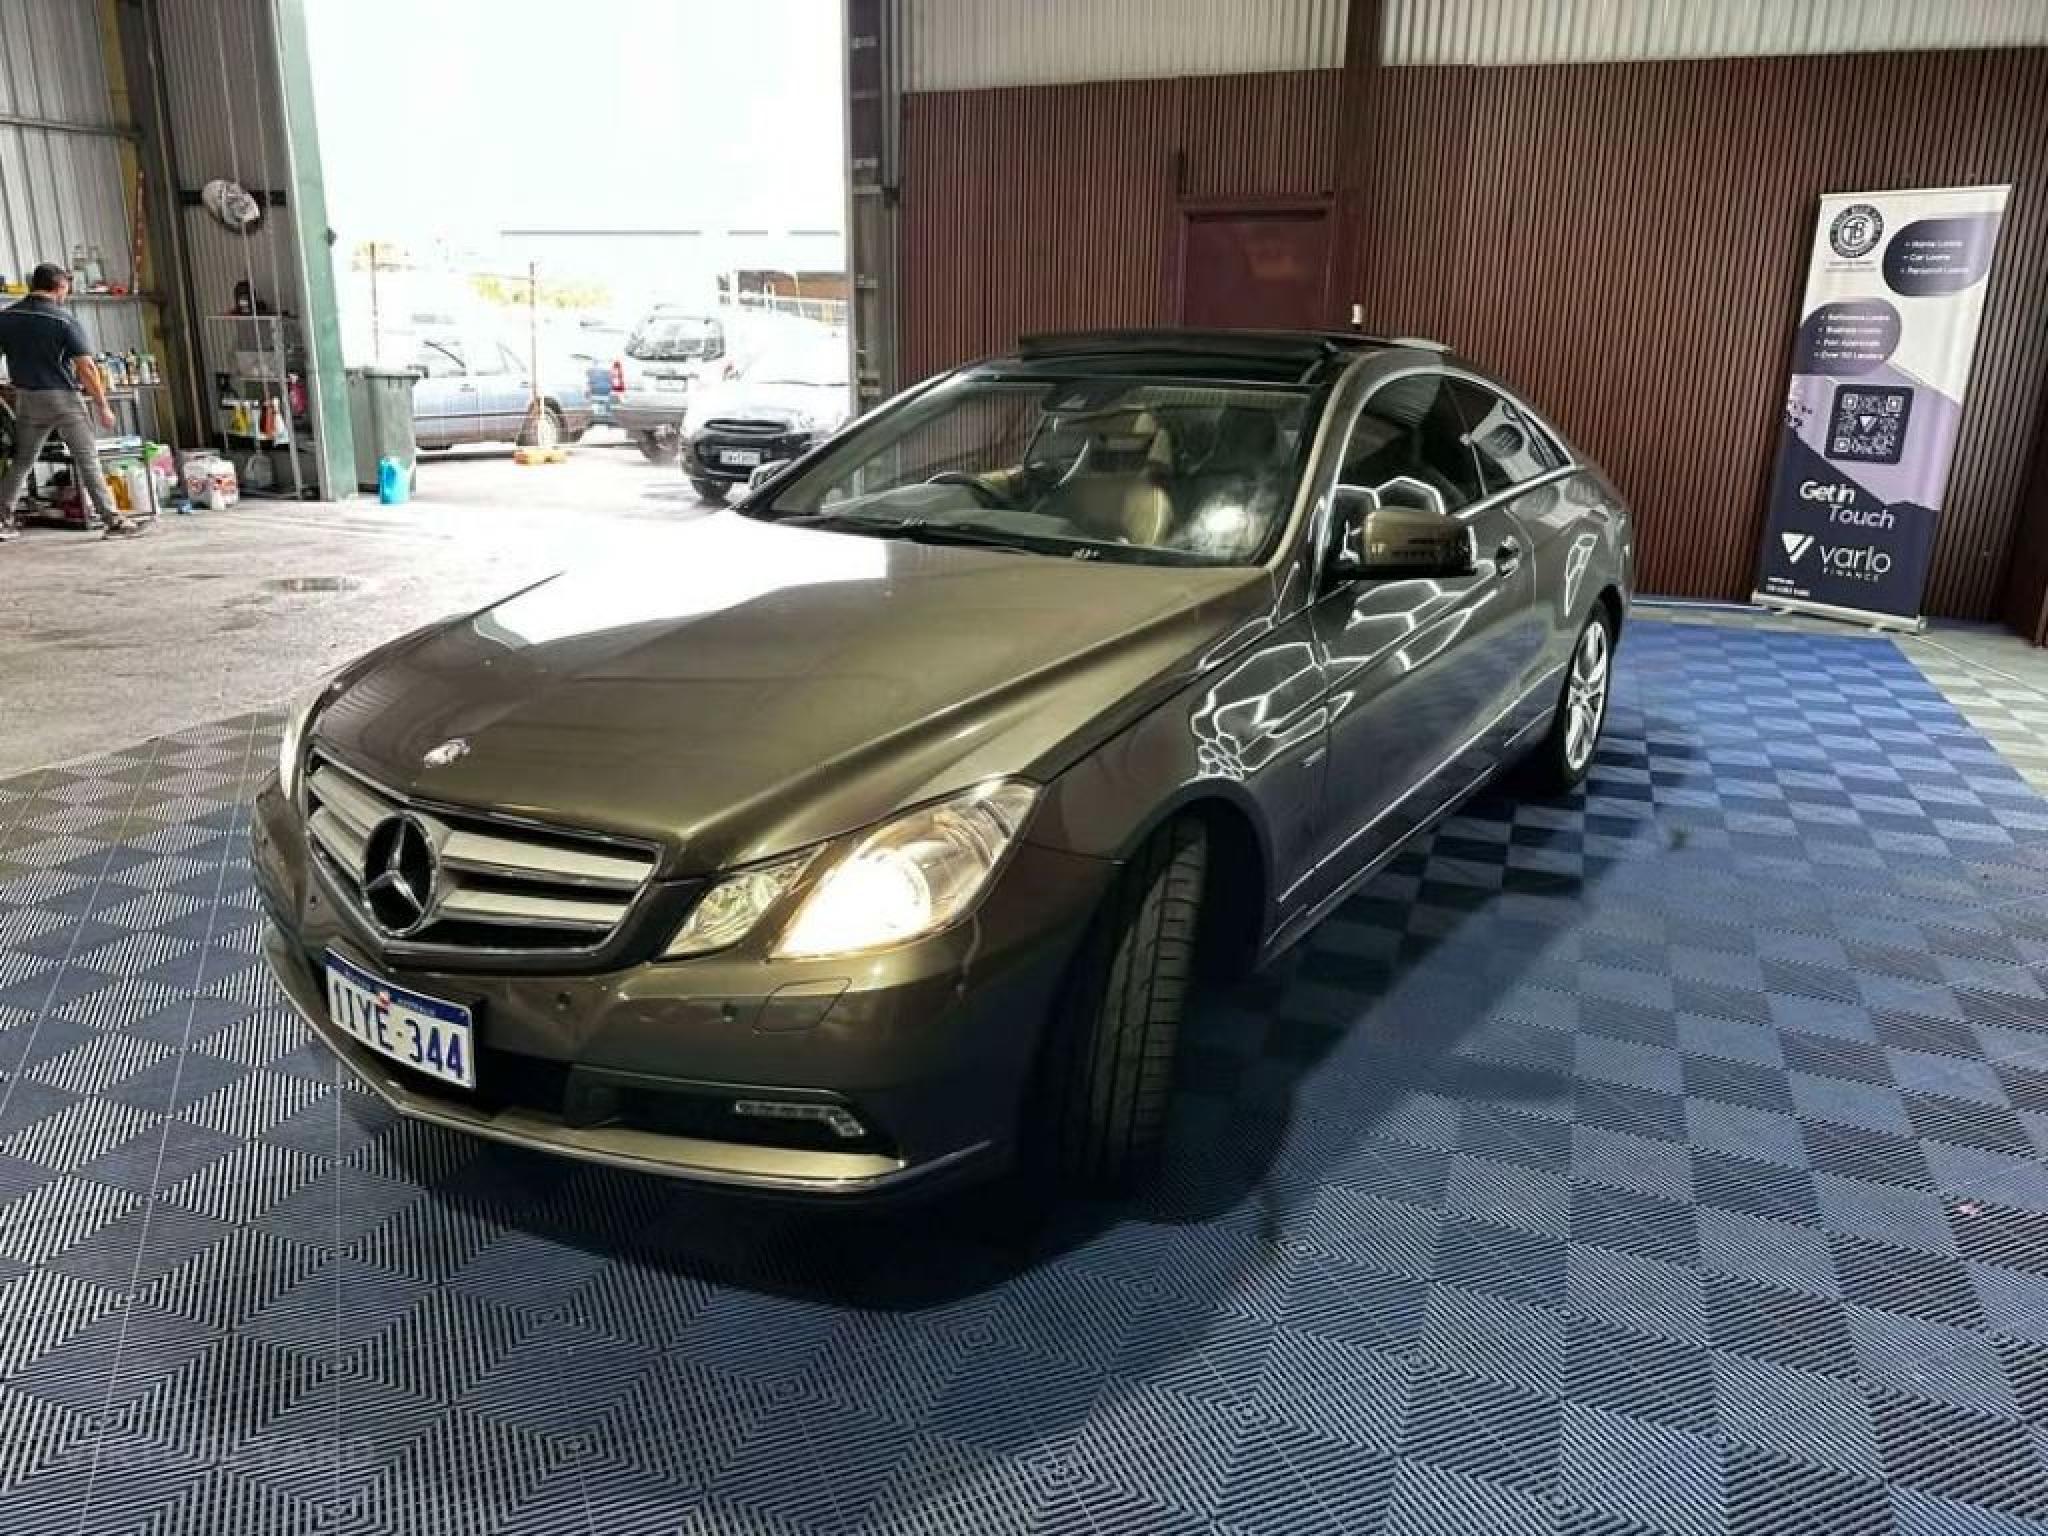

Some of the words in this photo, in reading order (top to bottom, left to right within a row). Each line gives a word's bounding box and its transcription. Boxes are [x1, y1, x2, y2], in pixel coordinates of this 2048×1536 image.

[1800, 481, 1836, 503] Get
[1828, 504, 1895, 529] Touch
[1819, 545, 1891, 573] varlo
